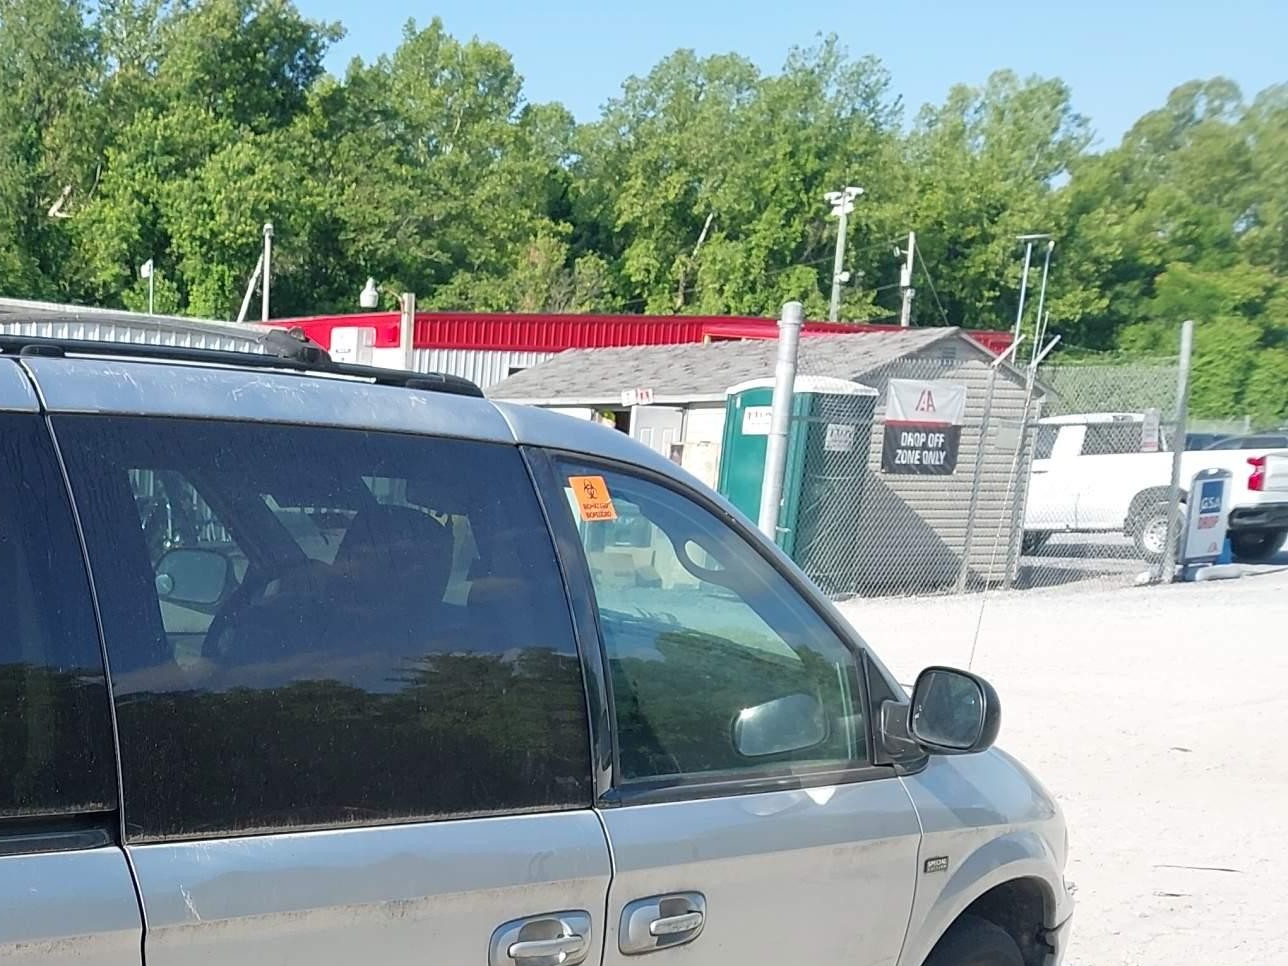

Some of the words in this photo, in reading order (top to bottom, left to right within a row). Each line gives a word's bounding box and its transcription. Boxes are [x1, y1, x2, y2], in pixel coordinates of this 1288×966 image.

[900, 431, 927, 448] DROP
[927, 432, 945, 448] OFF
[894, 449, 921, 465] ZONE
[922, 450, 947, 465] ONLY
